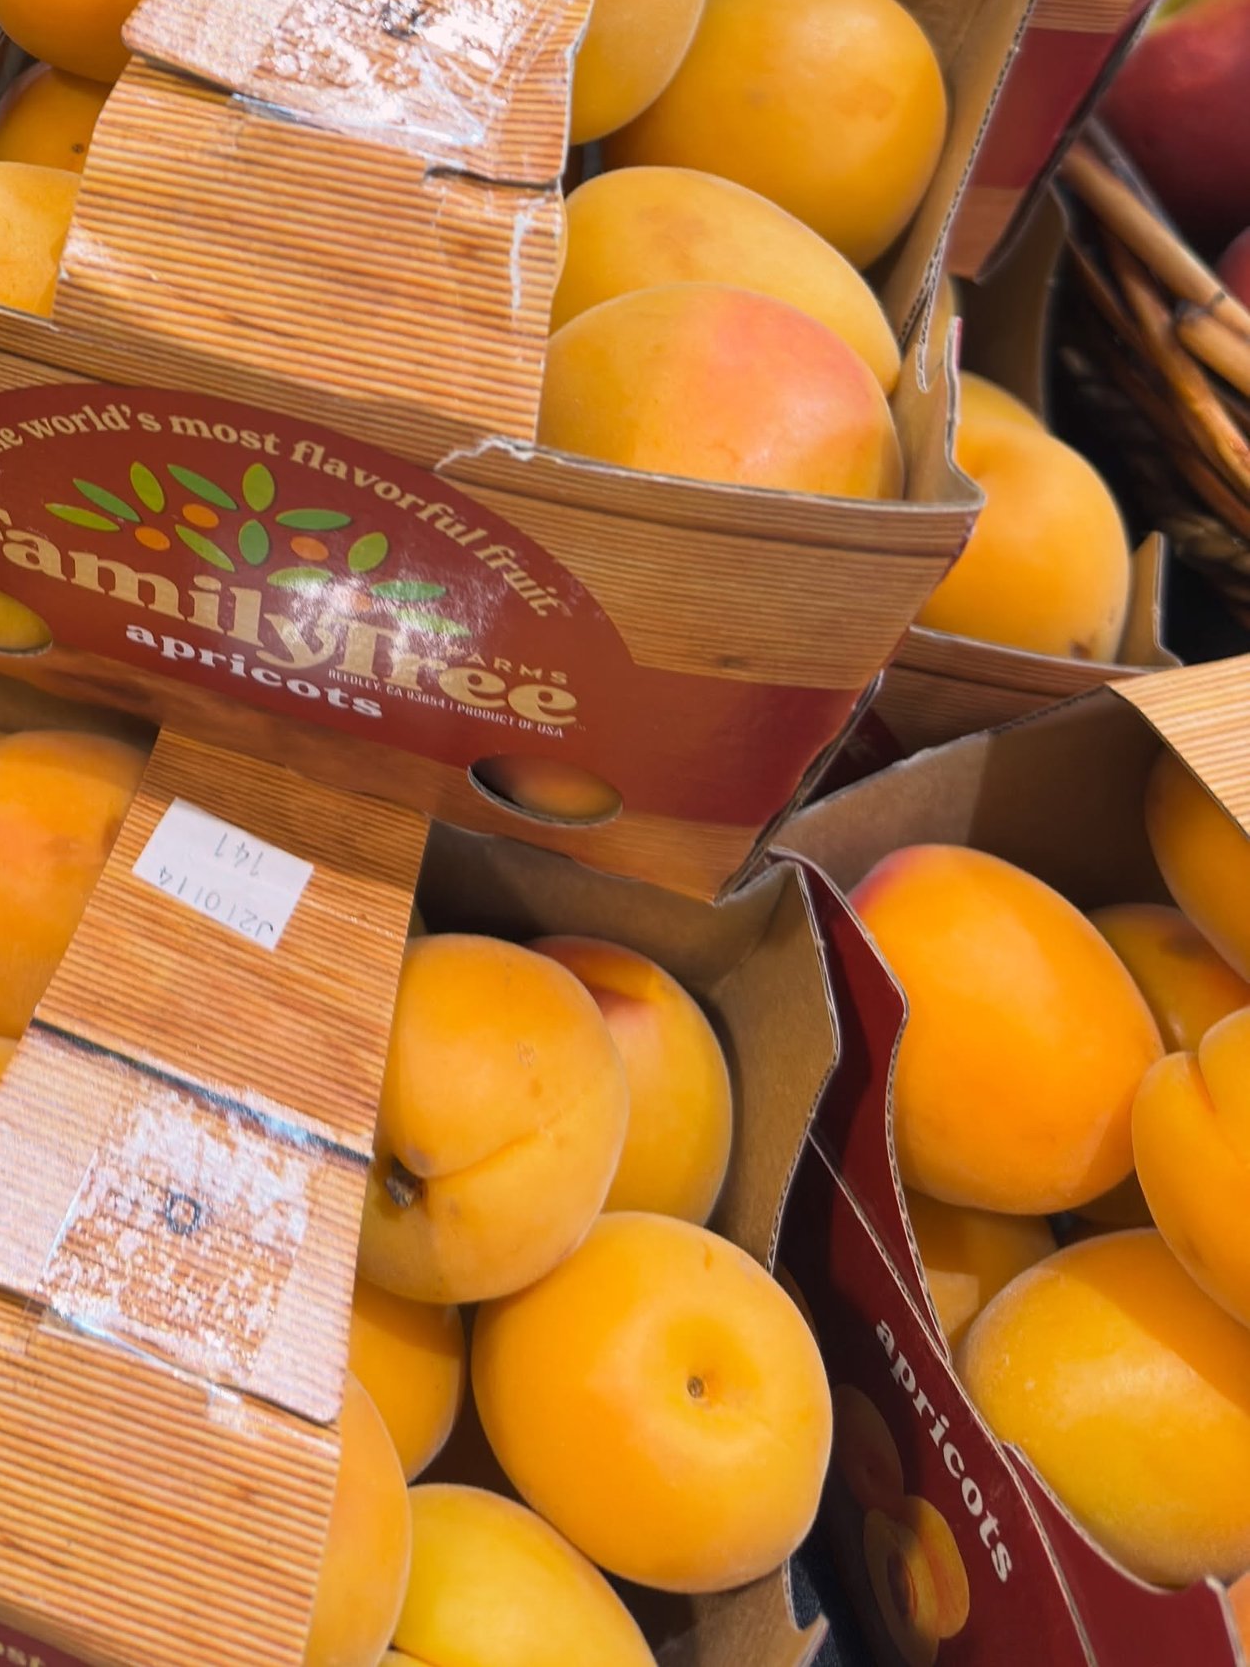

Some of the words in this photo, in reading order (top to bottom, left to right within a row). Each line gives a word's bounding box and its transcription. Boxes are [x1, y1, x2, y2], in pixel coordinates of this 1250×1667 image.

[18, 403, 162, 441] world's
[168, 414, 282, 456] most
[290, 439, 489, 547] flavorful
[125, 624, 384, 720] apricots
[386, 684, 404, 700] CA
[457, 704, 516, 726] PRODUCT
[518, 716, 534, 732] OF
[536, 722, 566, 739] USA
[214, 832, 265, 877] 141
[875, 1318, 1013, 1583] apricots
